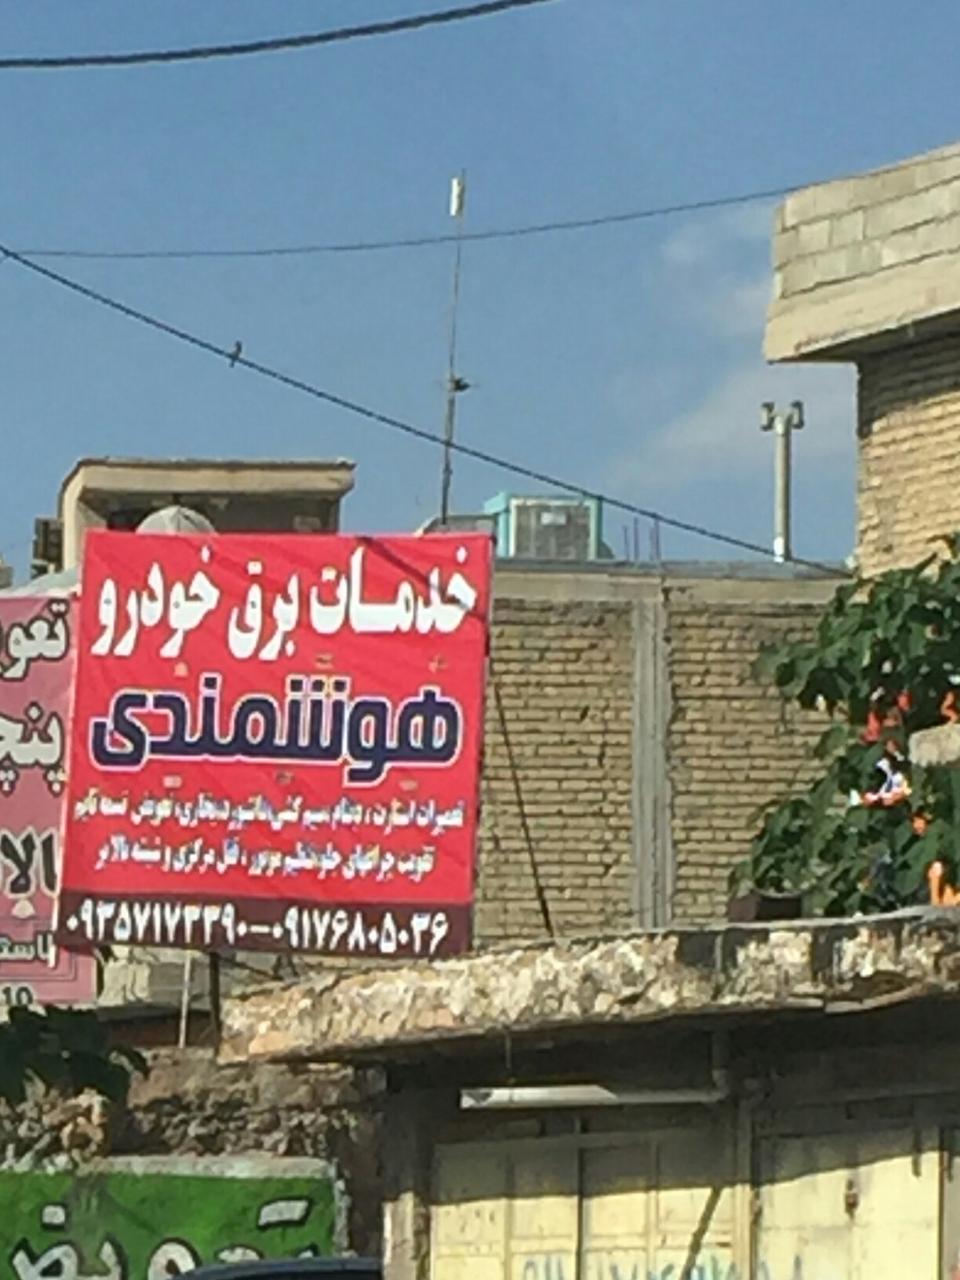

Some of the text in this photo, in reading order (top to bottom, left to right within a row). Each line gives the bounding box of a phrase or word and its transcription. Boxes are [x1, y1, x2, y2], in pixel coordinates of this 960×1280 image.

[91, 545, 478, 660] خدمات برق خودرو
[90, 673, 462, 787] هوشمندی
